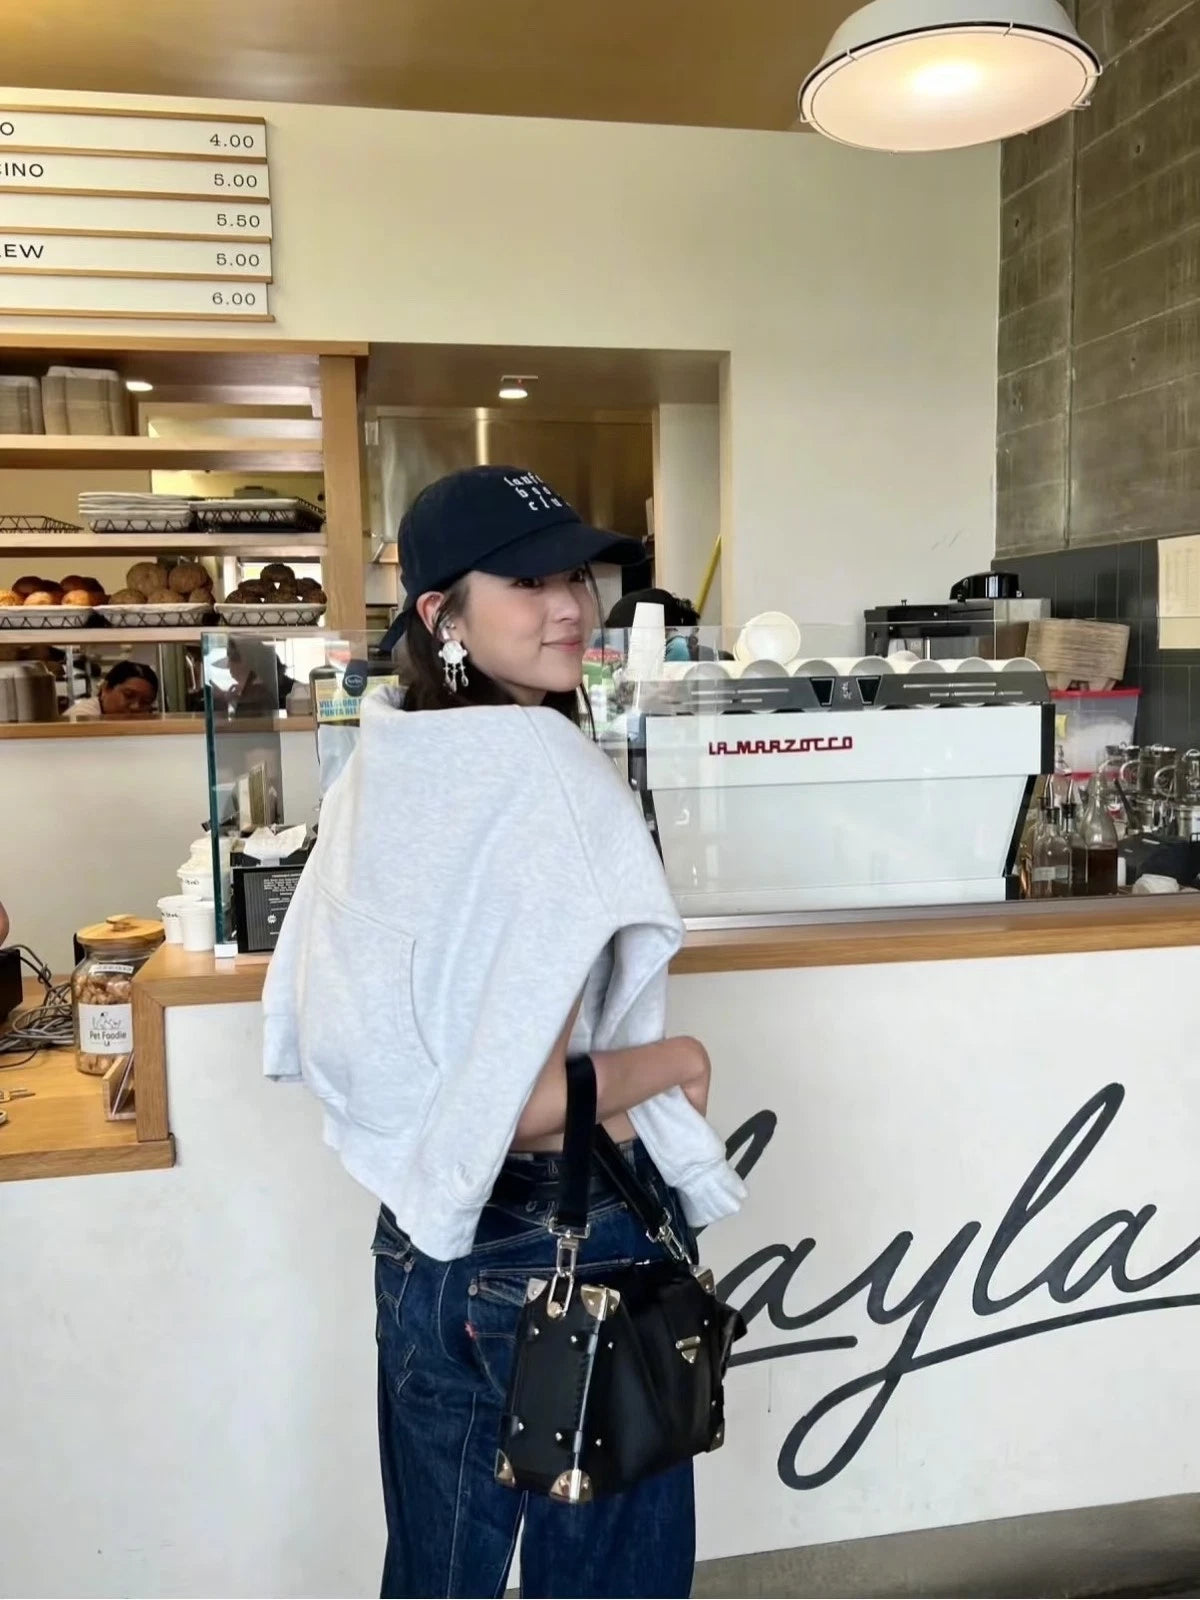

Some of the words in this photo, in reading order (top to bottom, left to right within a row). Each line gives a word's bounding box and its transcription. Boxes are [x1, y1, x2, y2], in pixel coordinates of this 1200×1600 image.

[209, 133, 254, 149] 4.00
[0, 162, 44, 178] INO
[214, 173, 258, 188] 5.00
[216, 213, 260, 228] 5.50
[0, 244, 44, 259] EW
[216, 253, 260, 267] 5.00
[212, 292, 256, 306] 6.00
[514, 486, 557, 499] boo
[528, 495, 570, 511] clu
[89, 1030, 101, 1040] Pet
[102, 1030, 127, 1040] Foodie
